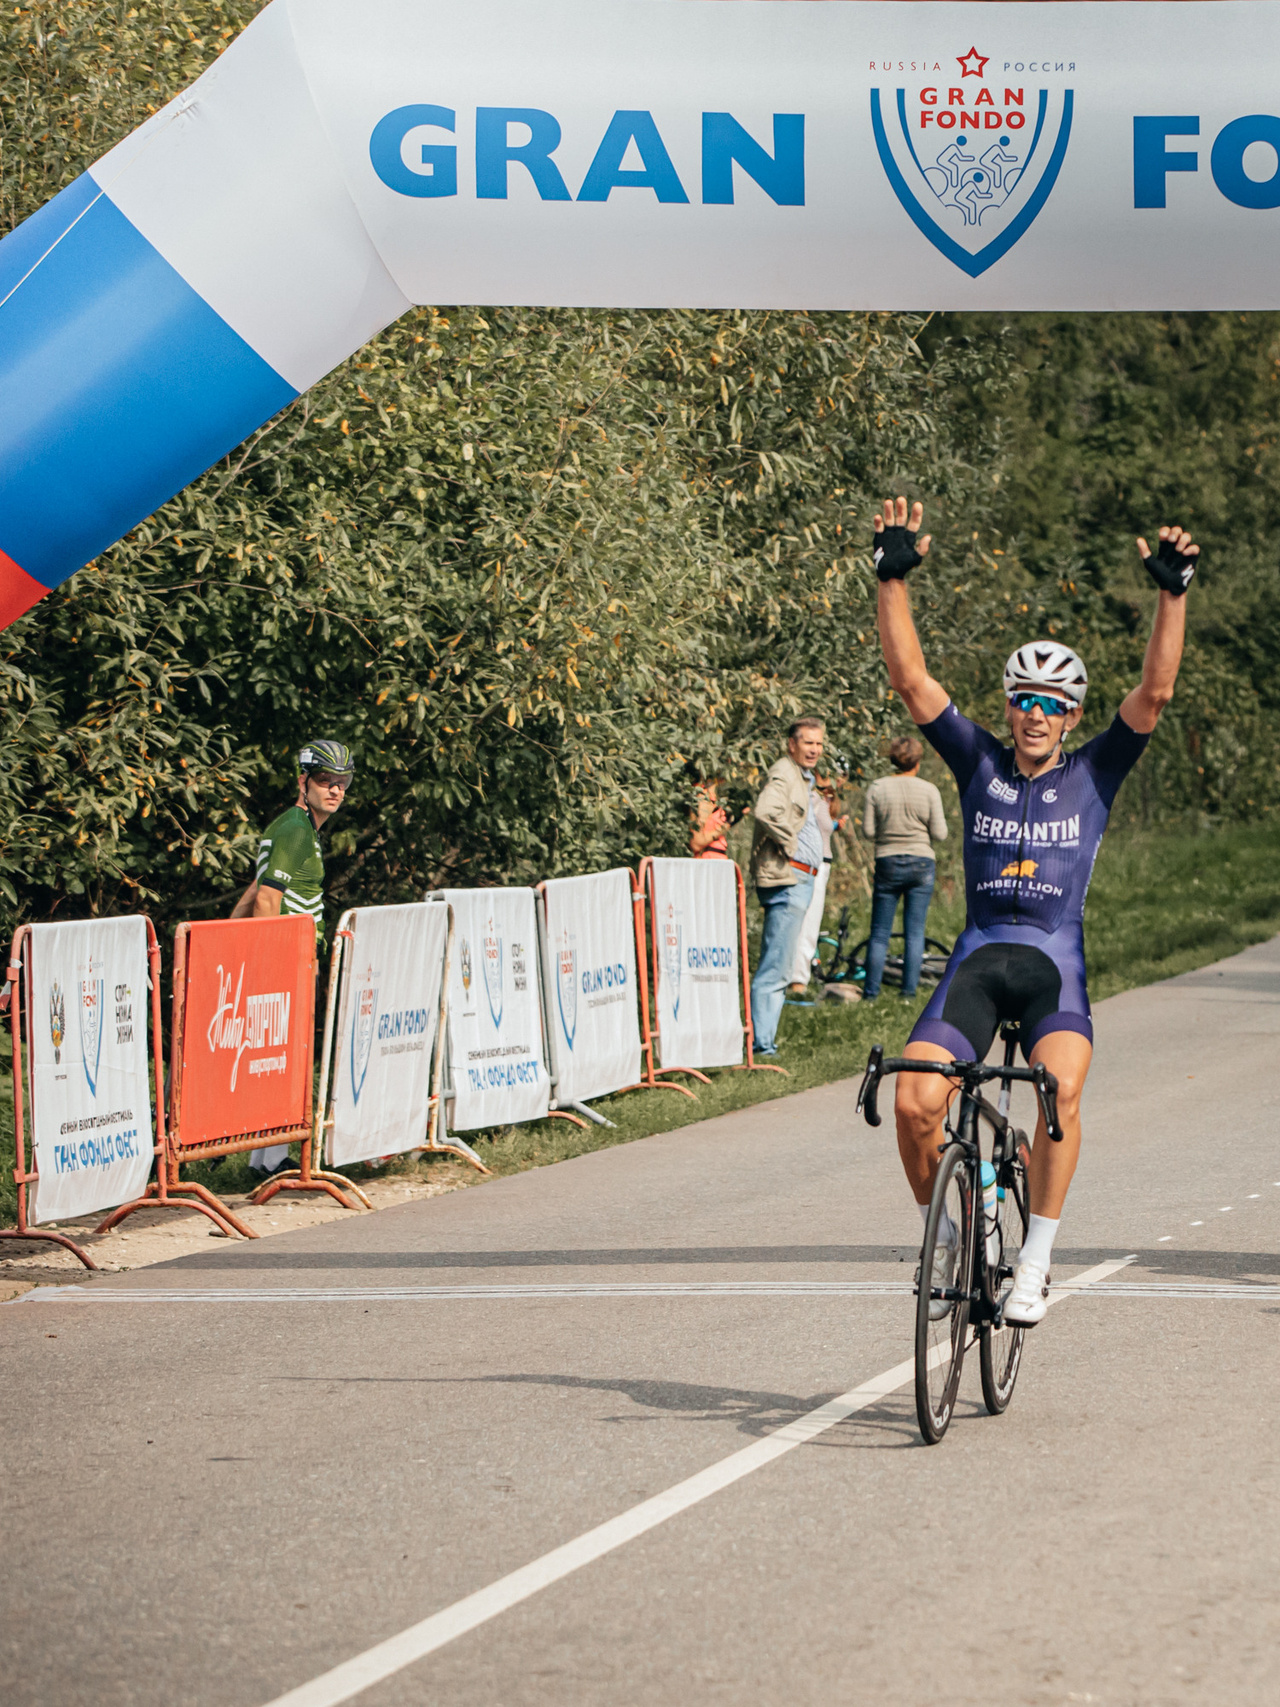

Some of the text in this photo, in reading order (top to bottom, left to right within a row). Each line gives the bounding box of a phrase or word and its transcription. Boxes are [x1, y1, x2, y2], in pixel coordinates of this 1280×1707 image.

[869, 61, 942, 72] RUSSIA
[1003, 62, 1077, 72] РОССИЯ
[919, 87, 1024, 106] GRAN
[920, 111, 1026, 130] FONDO
[369, 103, 806, 207] GRAN
[973, 811, 1080, 842] SERPANTIN
[976, 879, 1063, 897] AMBER LION
[378, 1008, 430, 1040] GRAN FOND
[79, 1134, 115, 1172] ФОНДО
[115, 1129, 139, 1160] ФЕСТ
